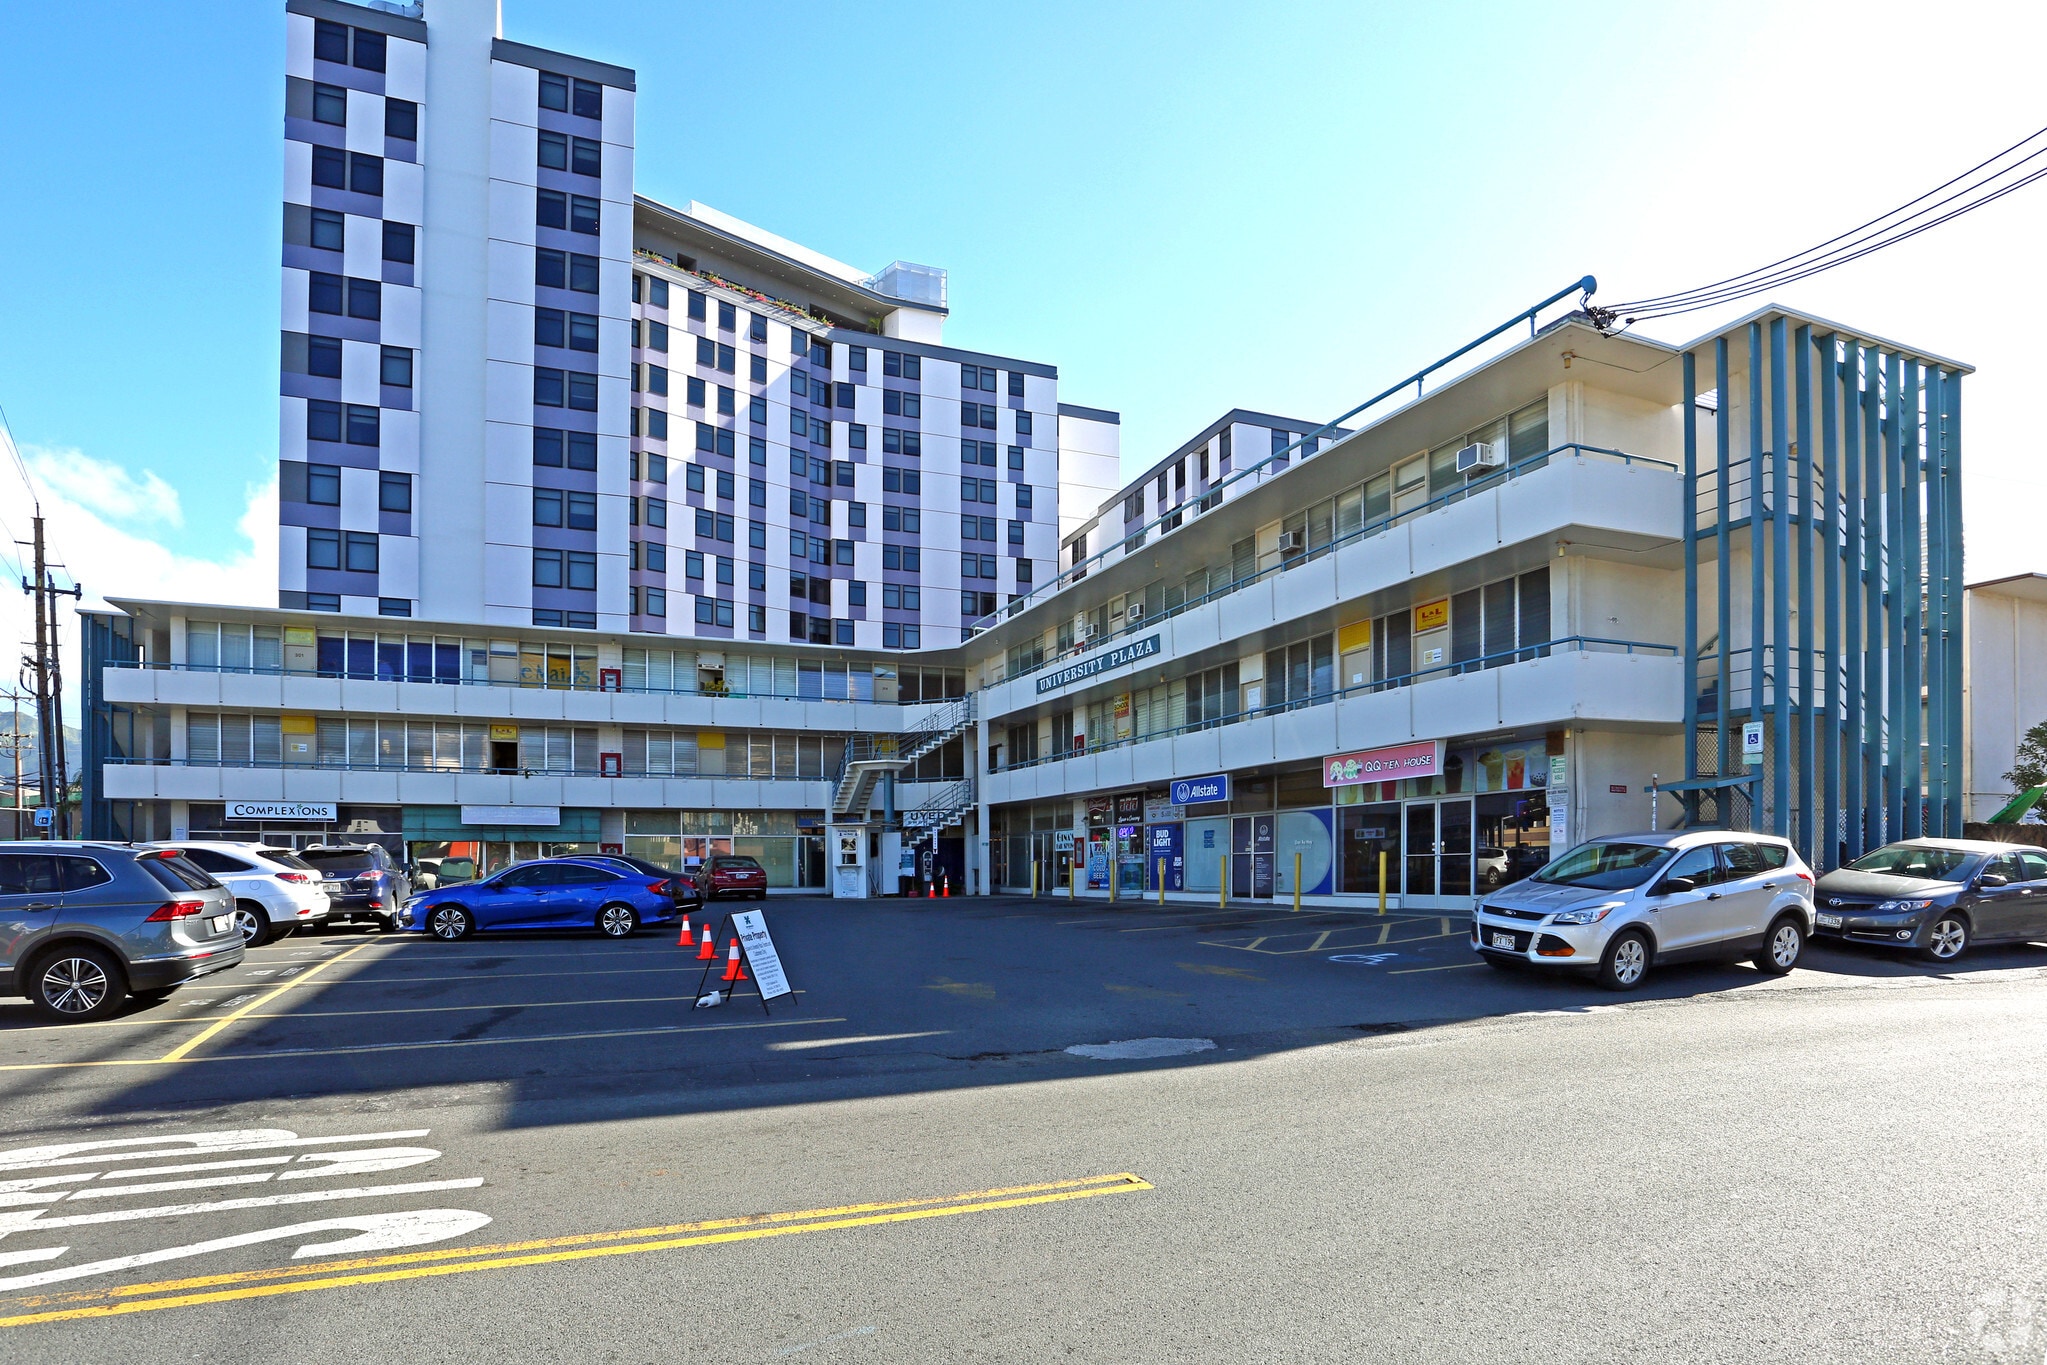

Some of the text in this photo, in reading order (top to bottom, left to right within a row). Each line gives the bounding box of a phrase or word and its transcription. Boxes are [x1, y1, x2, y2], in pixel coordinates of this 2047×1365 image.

[1040, 640, 1154, 691] UNIVERSITY PLAZA
[1365, 755, 1432, 772] QQ TEA HOUSE
[1190, 783, 1218, 798] Allstate
[1156, 830, 1168, 838] BUD
[1154, 838, 1171, 847] LIGHT
